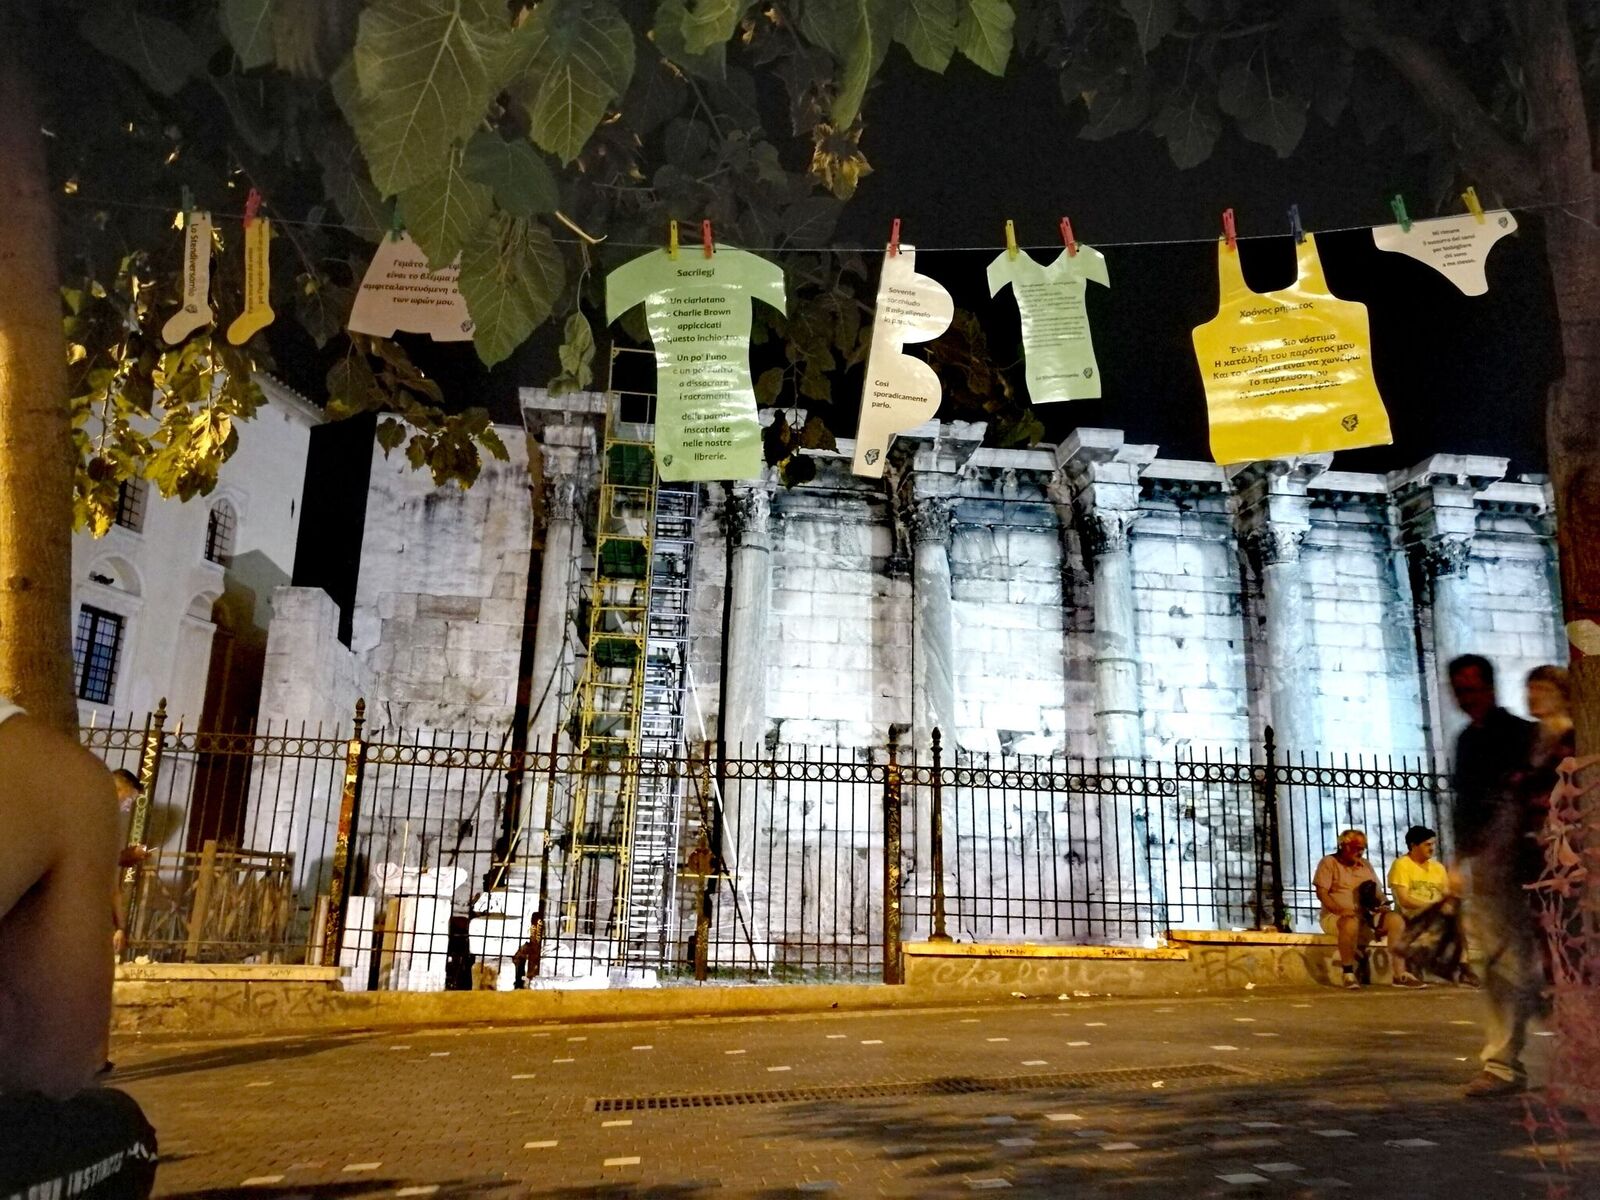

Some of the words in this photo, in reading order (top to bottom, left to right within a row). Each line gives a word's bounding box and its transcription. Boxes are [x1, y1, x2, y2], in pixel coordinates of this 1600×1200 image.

[393, 259, 424, 269] Γεμάτο
[386, 271, 406, 280] είναι
[677, 268, 715, 278] Sacrilegi
[888, 287, 916, 296] Sovente
[683, 296, 726, 304] ciarlatano
[673, 309, 702, 317] Charlie
[703, 308, 731, 316] Brown
[1239, 306, 1273, 318] Χρόνος
[677, 321, 722, 331] appiccicati
[1299, 334, 1336, 344] νόστιμο
[1290, 346, 1335, 358] παρόντος
[1336, 343, 1356, 352] μου
[691, 353, 704, 362] po'
[705, 353, 727, 361] l'uno
[873, 390, 928, 403] sporadicamente
[871, 401, 892, 409] parlo.
[684, 425, 731, 434] inscatolate
[682, 439, 703, 447] nelle
[705, 439, 732, 447] nostre
[694, 452, 727, 461] librerie.
